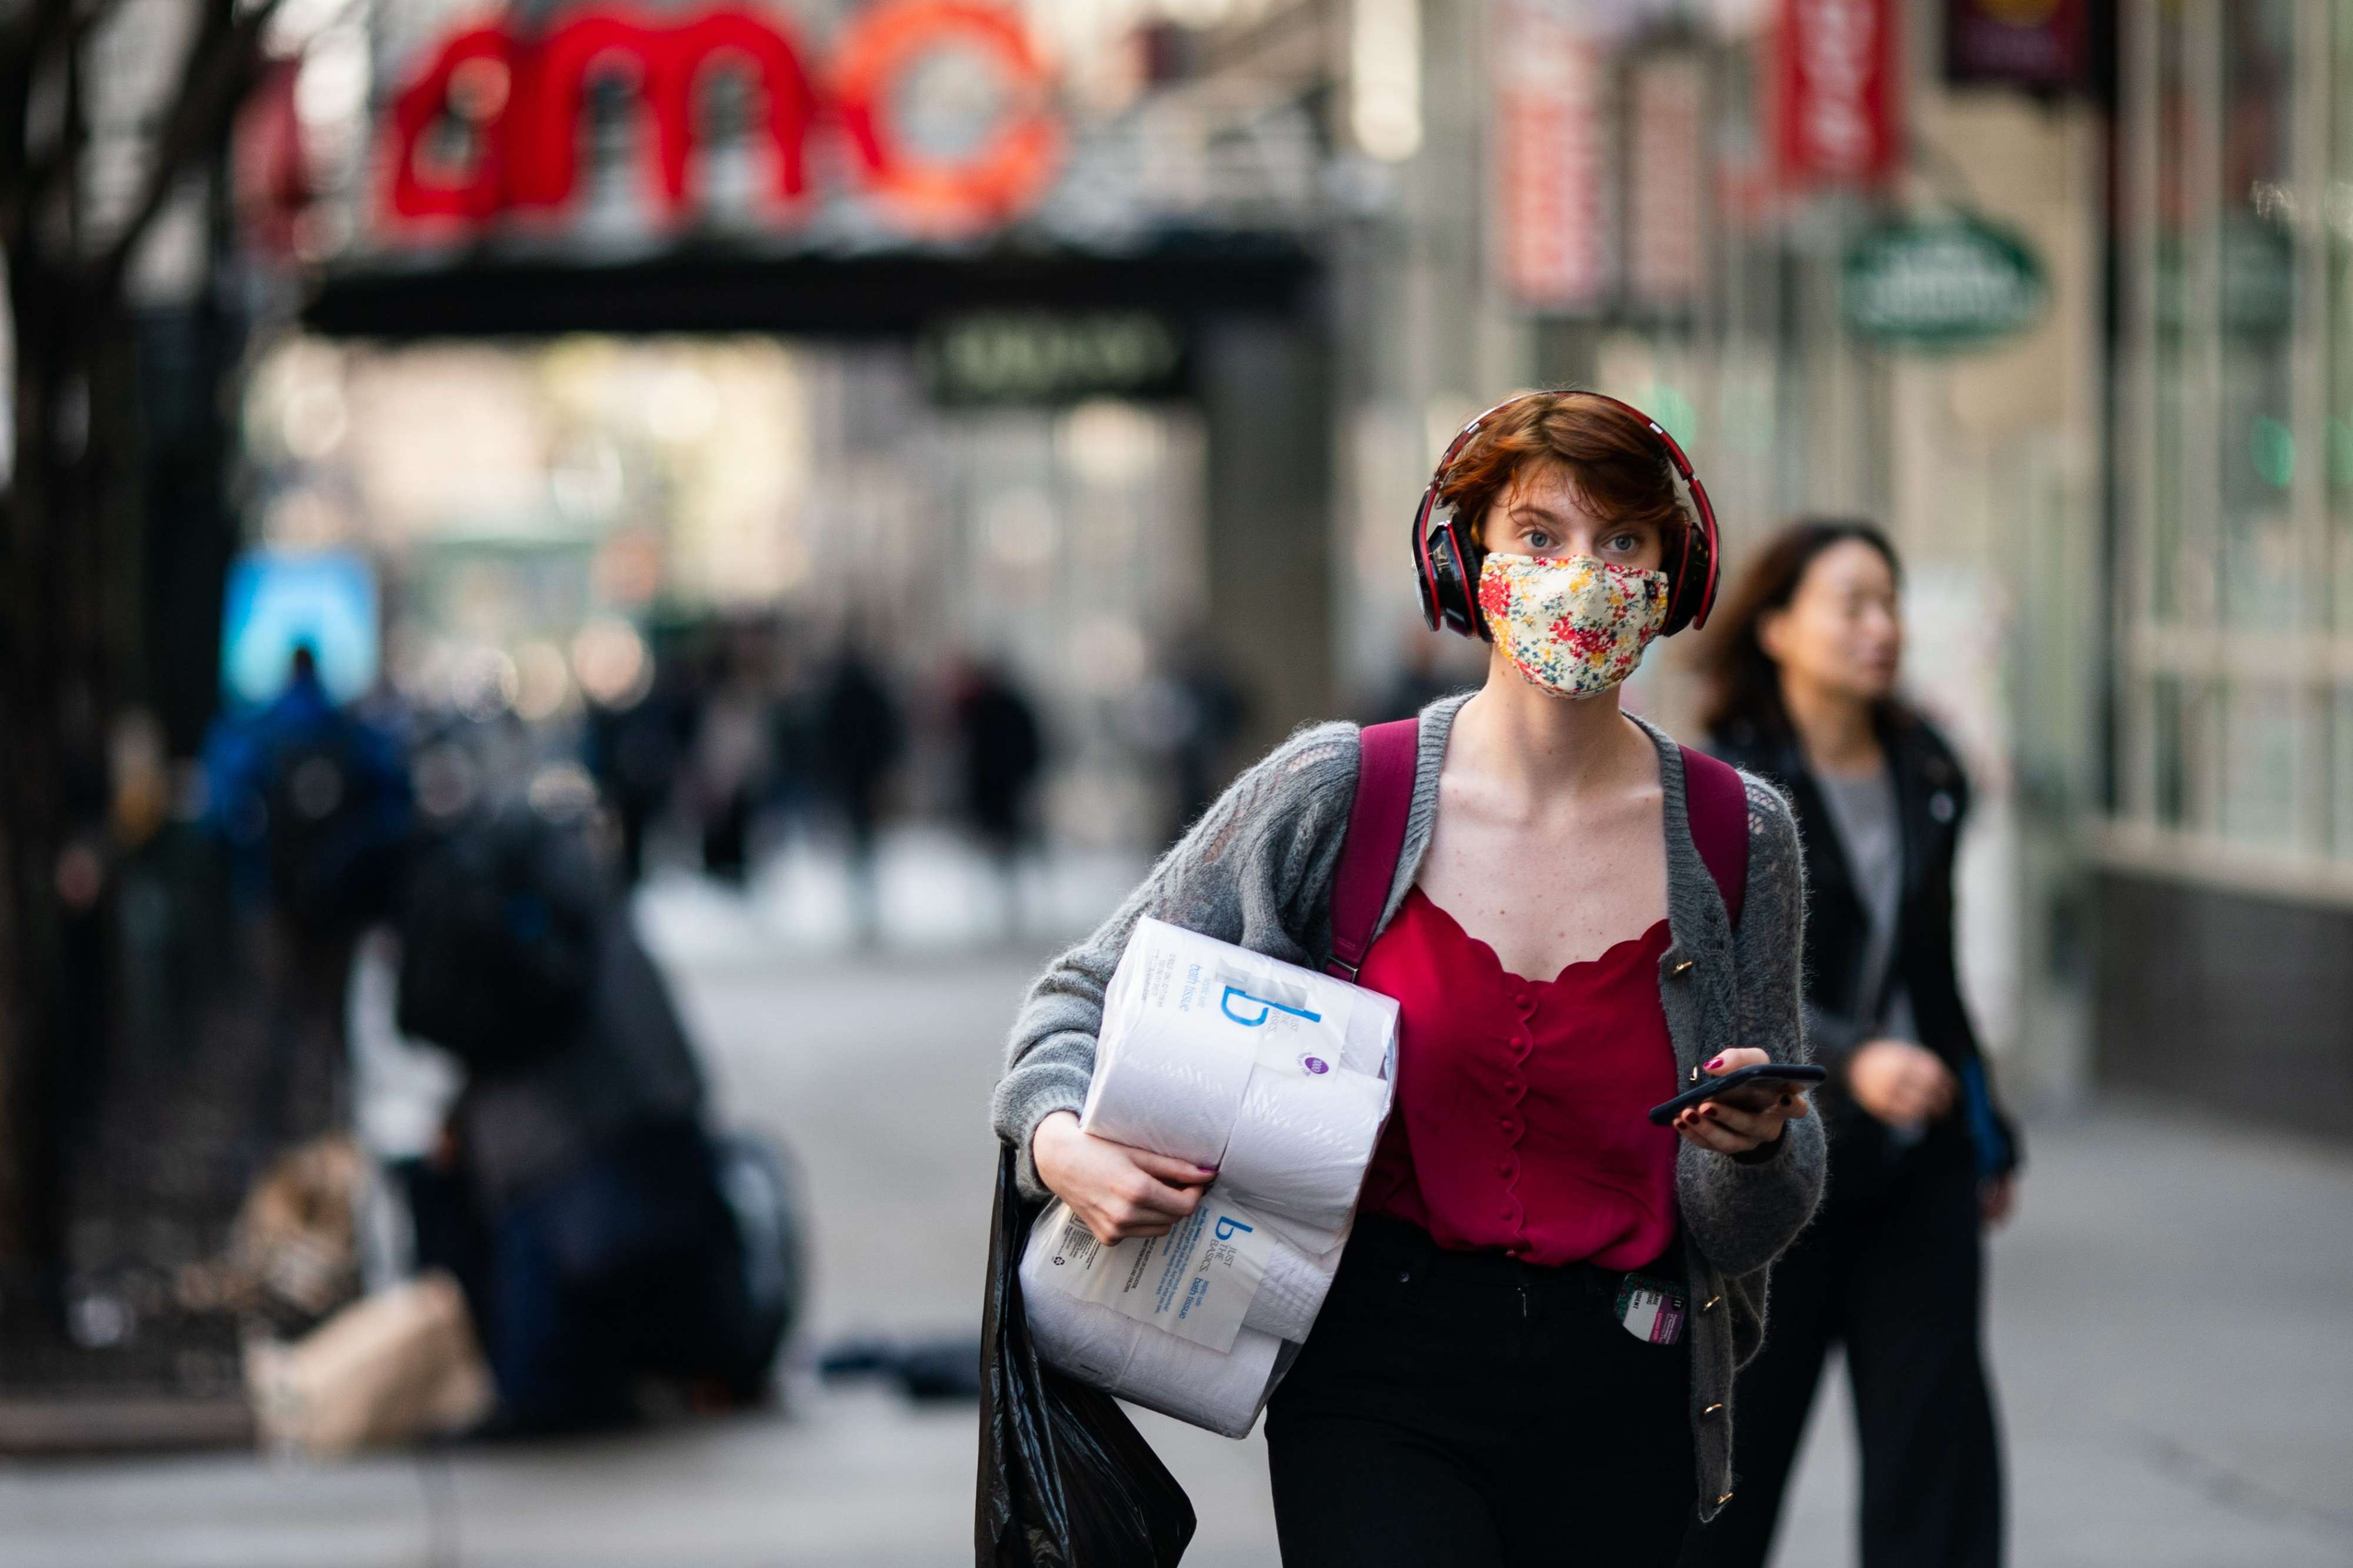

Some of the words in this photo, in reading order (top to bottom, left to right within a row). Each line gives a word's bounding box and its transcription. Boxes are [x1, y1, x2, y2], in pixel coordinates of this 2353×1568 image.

[1186, 963, 1203, 985] bath
[1178, 985, 1197, 1012] tissue
[1215, 1243, 1227, 1260] THE
[1223, 1247, 1237, 1267] JUST
[1189, 1276, 1202, 1296] bath
[1179, 1296, 1194, 1319] tissue
[1633, 1289, 1643, 1309] TUDENT
